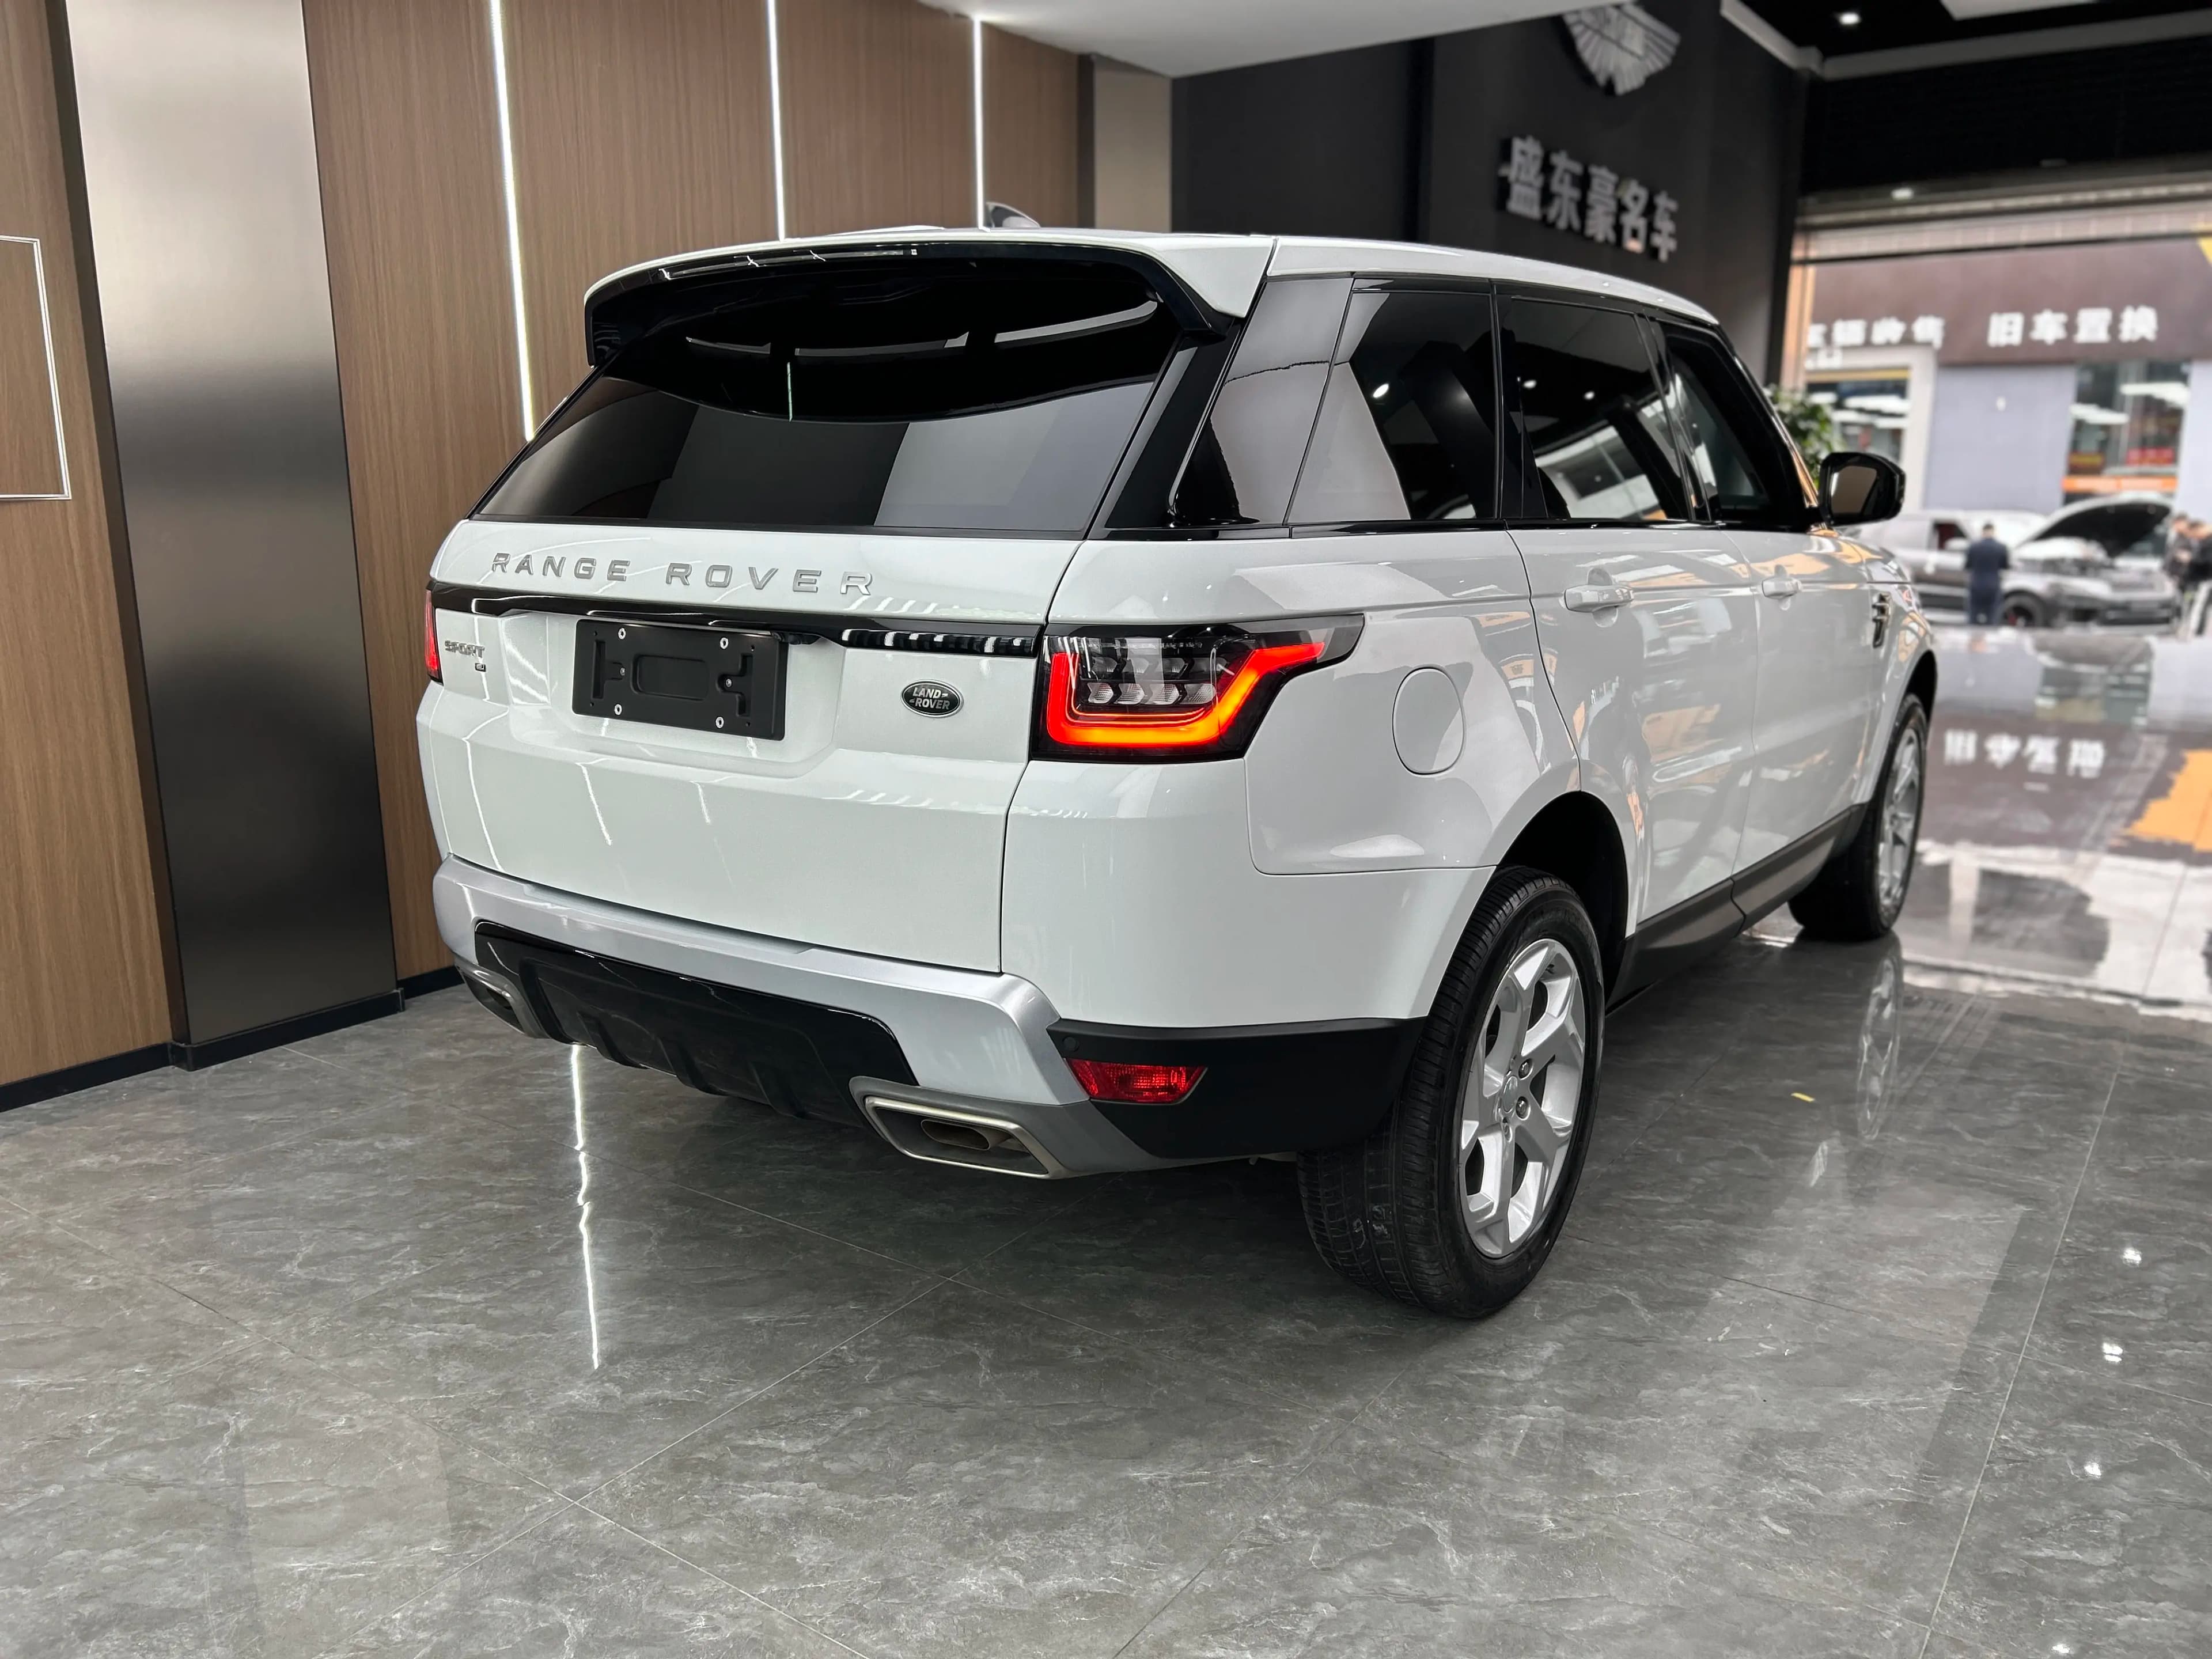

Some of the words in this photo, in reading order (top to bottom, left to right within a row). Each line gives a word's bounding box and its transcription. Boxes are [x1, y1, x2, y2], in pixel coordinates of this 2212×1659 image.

[1505, 135, 1679, 262] 盛东豪名车
[1987, 305, 2158, 347] 旧车置换
[491, 552, 631, 582] RANGE
[665, 562, 873, 596] ROVER
[445, 640, 485, 658] SPORT
[912, 687, 941, 699] LAND
[915, 697, 950, 710] ROVER
